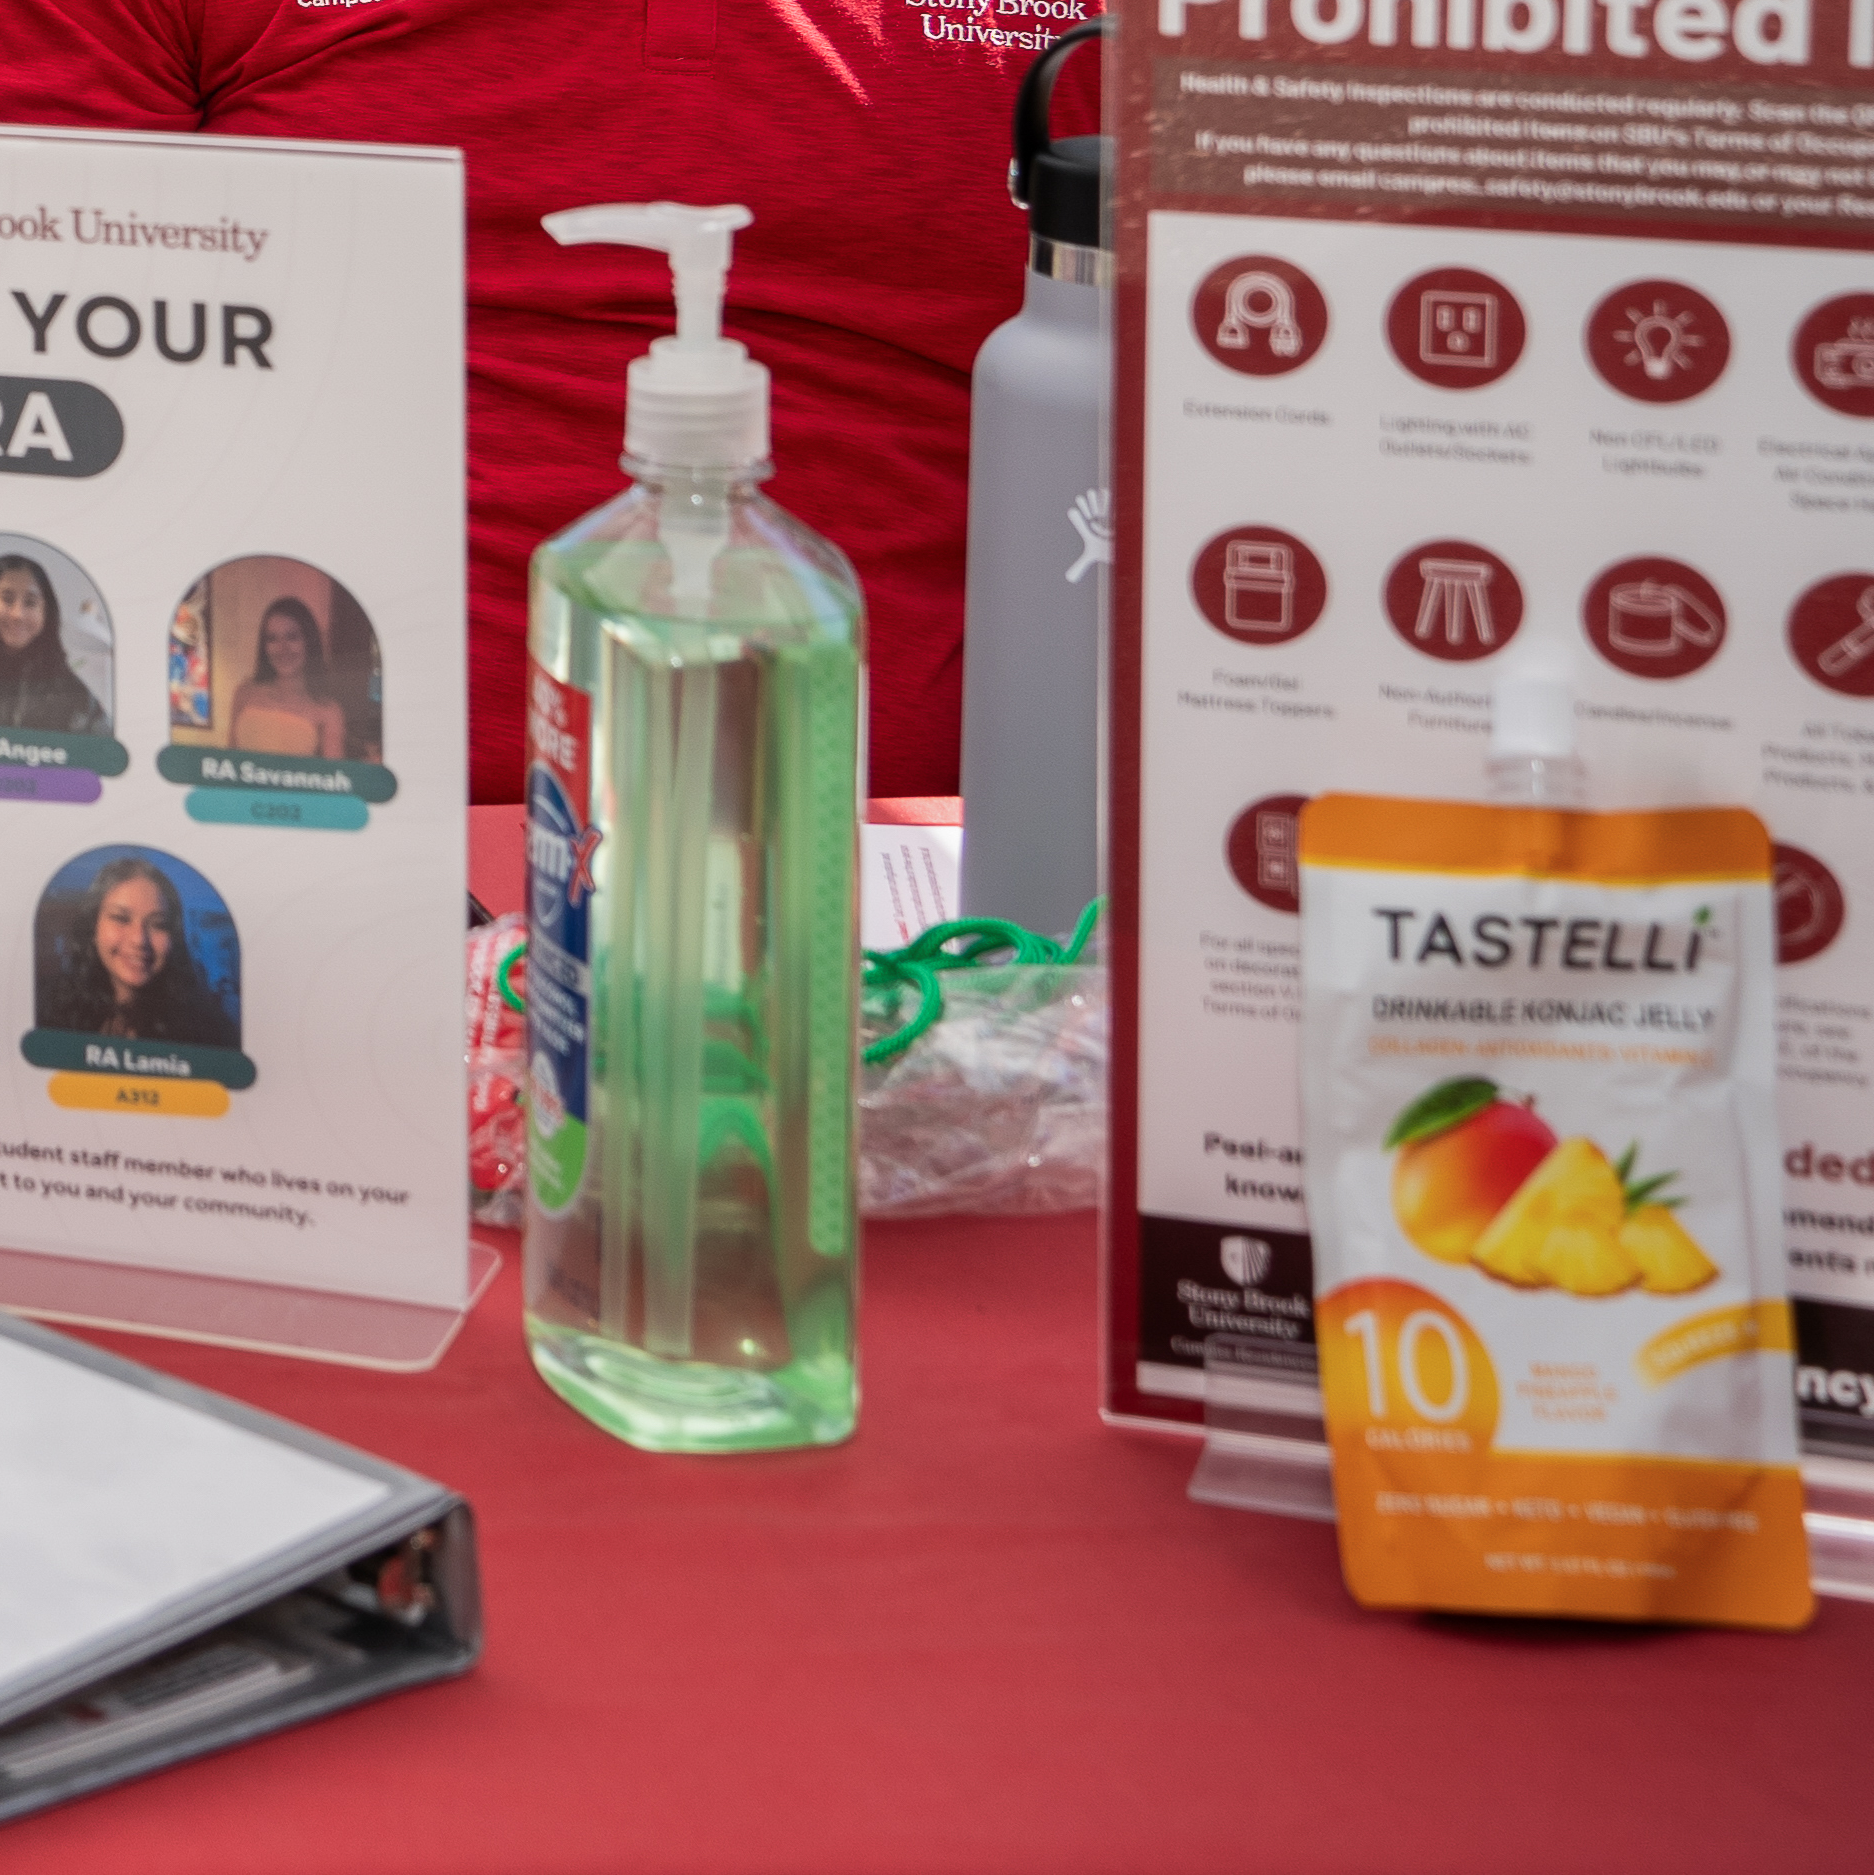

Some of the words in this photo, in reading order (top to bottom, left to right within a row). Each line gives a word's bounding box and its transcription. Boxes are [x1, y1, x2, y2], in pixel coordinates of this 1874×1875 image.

[921, 13, 1063, 51] Universit
[70, 207, 269, 262] University
[9, 289, 276, 370] YOUR
[201, 757, 238, 782] RA
[239, 760, 352, 793] Savannah
[85, 1043, 121, 1070] RA
[123, 1047, 192, 1078] Lamia
[13, 1172, 37, 1194] to
[41, 1178, 82, 1201] you
[85, 1183, 126, 1205] and
[128, 1188, 178, 1212] your
[182, 1194, 317, 1231] community.
[69, 1148, 121, 1172] staff
[123, 1157, 215, 1181] member
[219, 1165, 268, 1190] who
[270, 1168, 322, 1196] lives
[325, 1180, 353, 1198] on
[358, 1186, 410, 1208] your
[1343, 1308, 1471, 1425] 10
